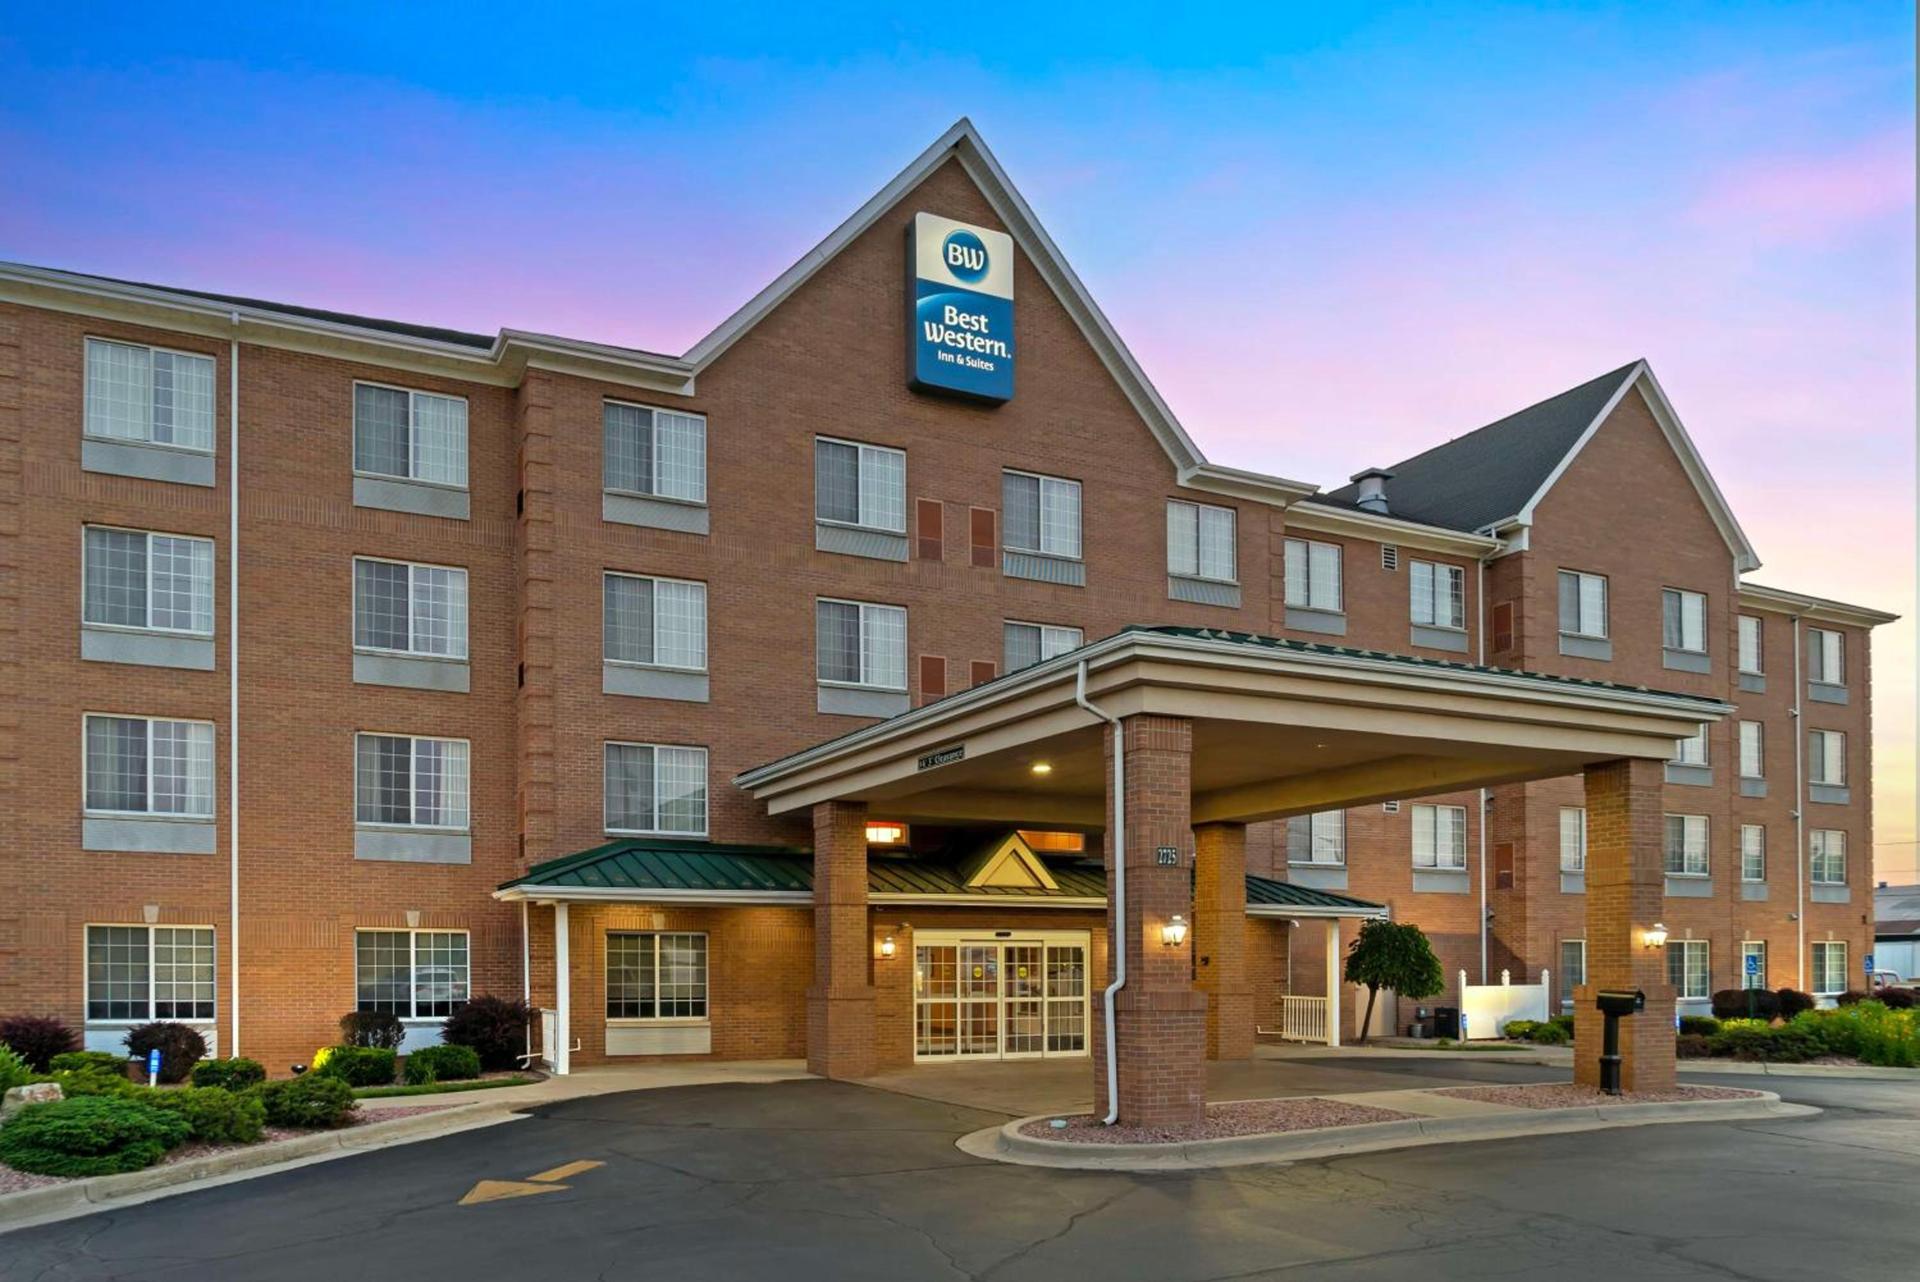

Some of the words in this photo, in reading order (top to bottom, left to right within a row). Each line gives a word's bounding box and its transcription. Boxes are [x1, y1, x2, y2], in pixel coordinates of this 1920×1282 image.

[947, 242, 985, 272] BW
[943, 304, 989, 334] Best
[937, 350, 955, 364] Inn
[956, 354, 965, 366] &
[965, 356, 995, 372] Suites
[1158, 848, 1176, 865] 2725
